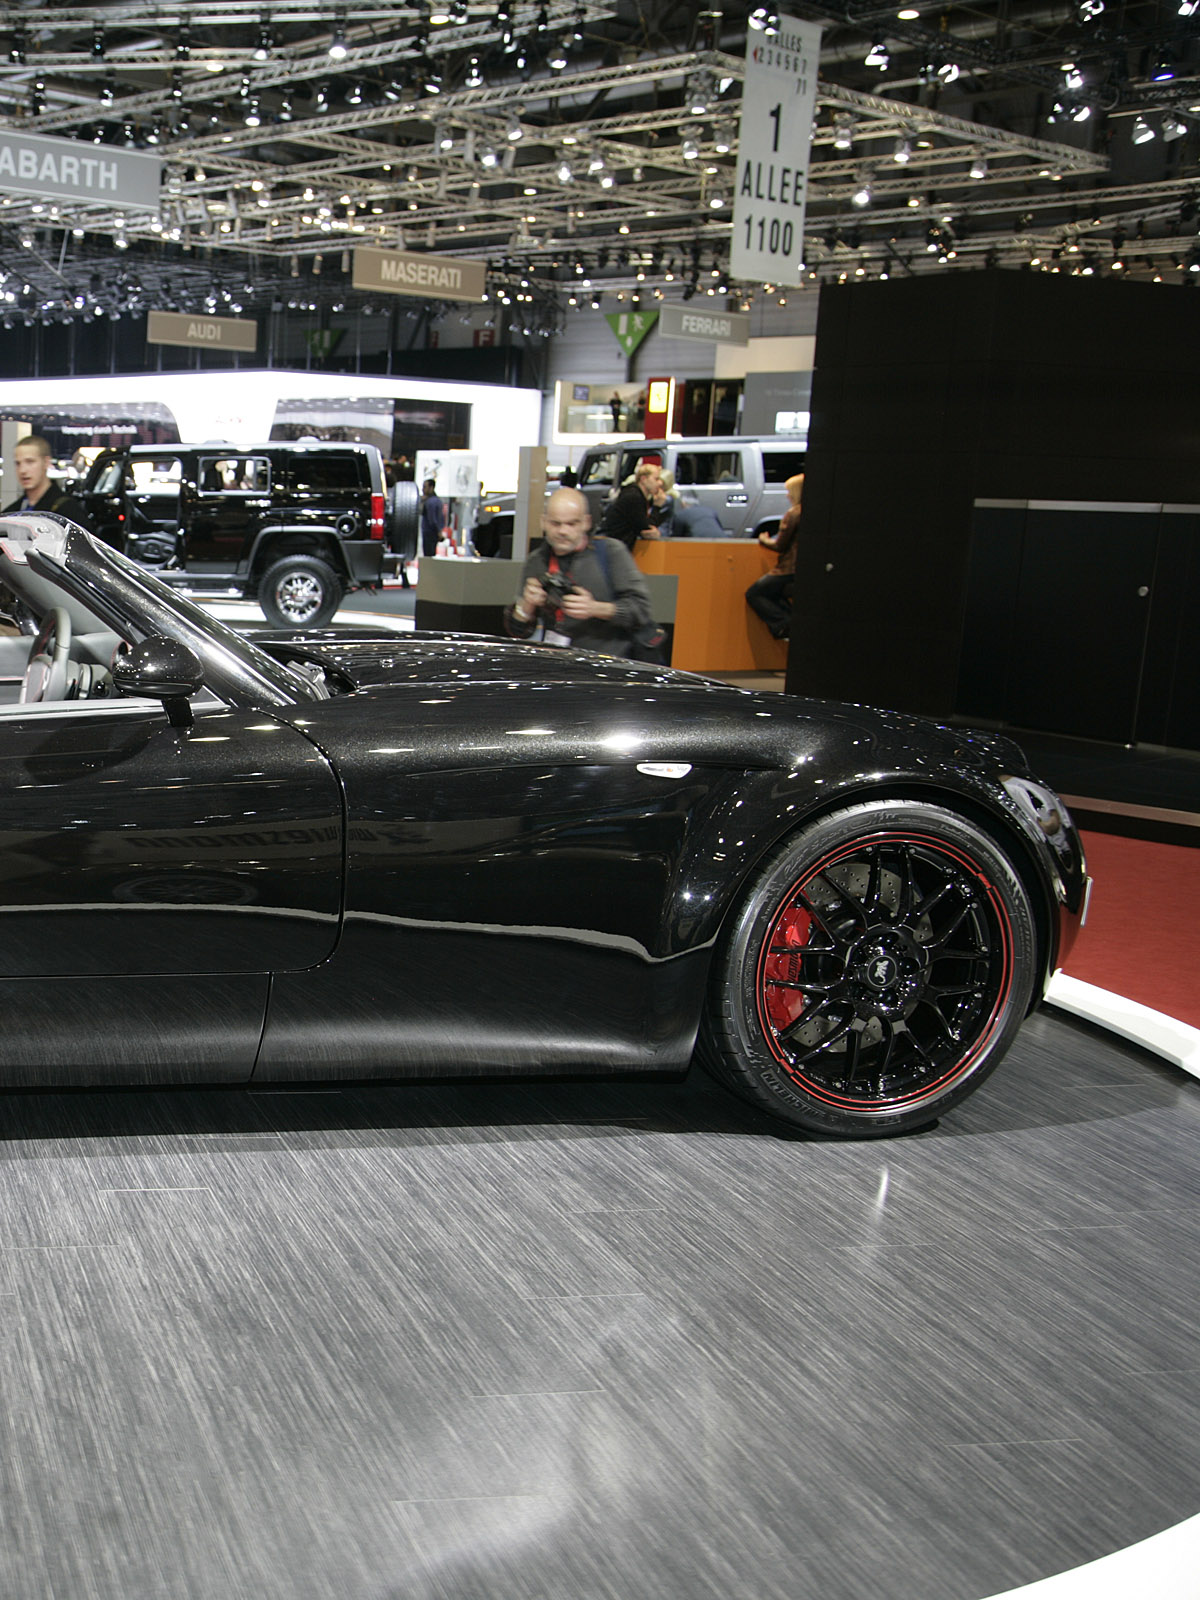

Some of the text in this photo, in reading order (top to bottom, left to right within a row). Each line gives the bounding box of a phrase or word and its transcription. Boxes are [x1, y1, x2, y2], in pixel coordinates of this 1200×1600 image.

[769, 103, 782, 153] 1
[741, 160, 804, 207] ALLEE
[745, 214, 793, 256] 1100
[380, 259, 462, 289] MASERATI
[187, 322, 221, 341] AUDI
[681, 314, 732, 337] FERRARI
